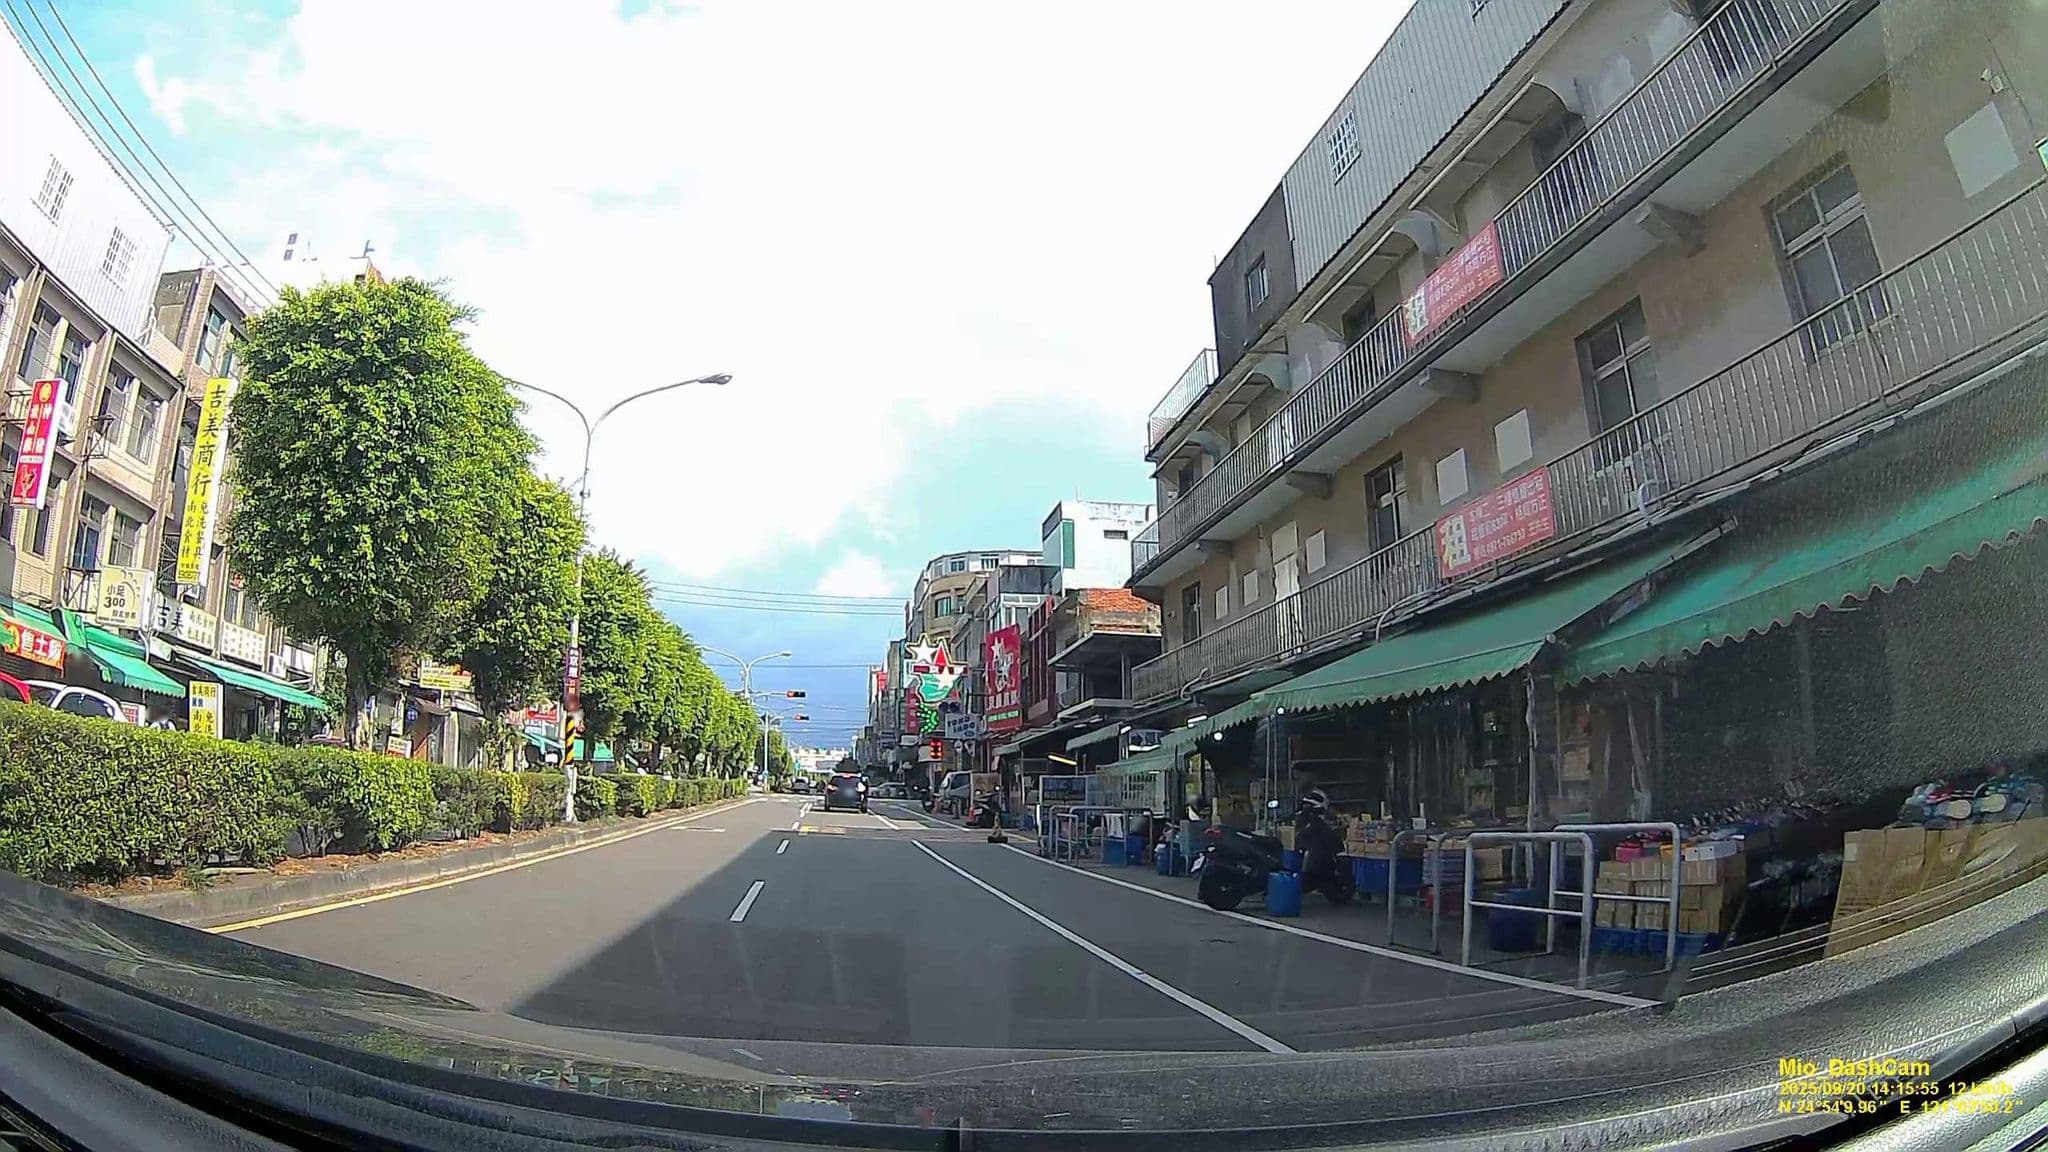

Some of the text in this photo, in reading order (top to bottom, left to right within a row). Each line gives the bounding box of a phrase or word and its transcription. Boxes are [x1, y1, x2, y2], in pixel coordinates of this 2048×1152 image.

[191, 384, 226, 497] 吉美商行
[103, 597, 126, 608] 300
[107, 585, 125, 598] 小足
[157, 599, 185, 634] 吉美
[193, 710, 203, 734] 南北
